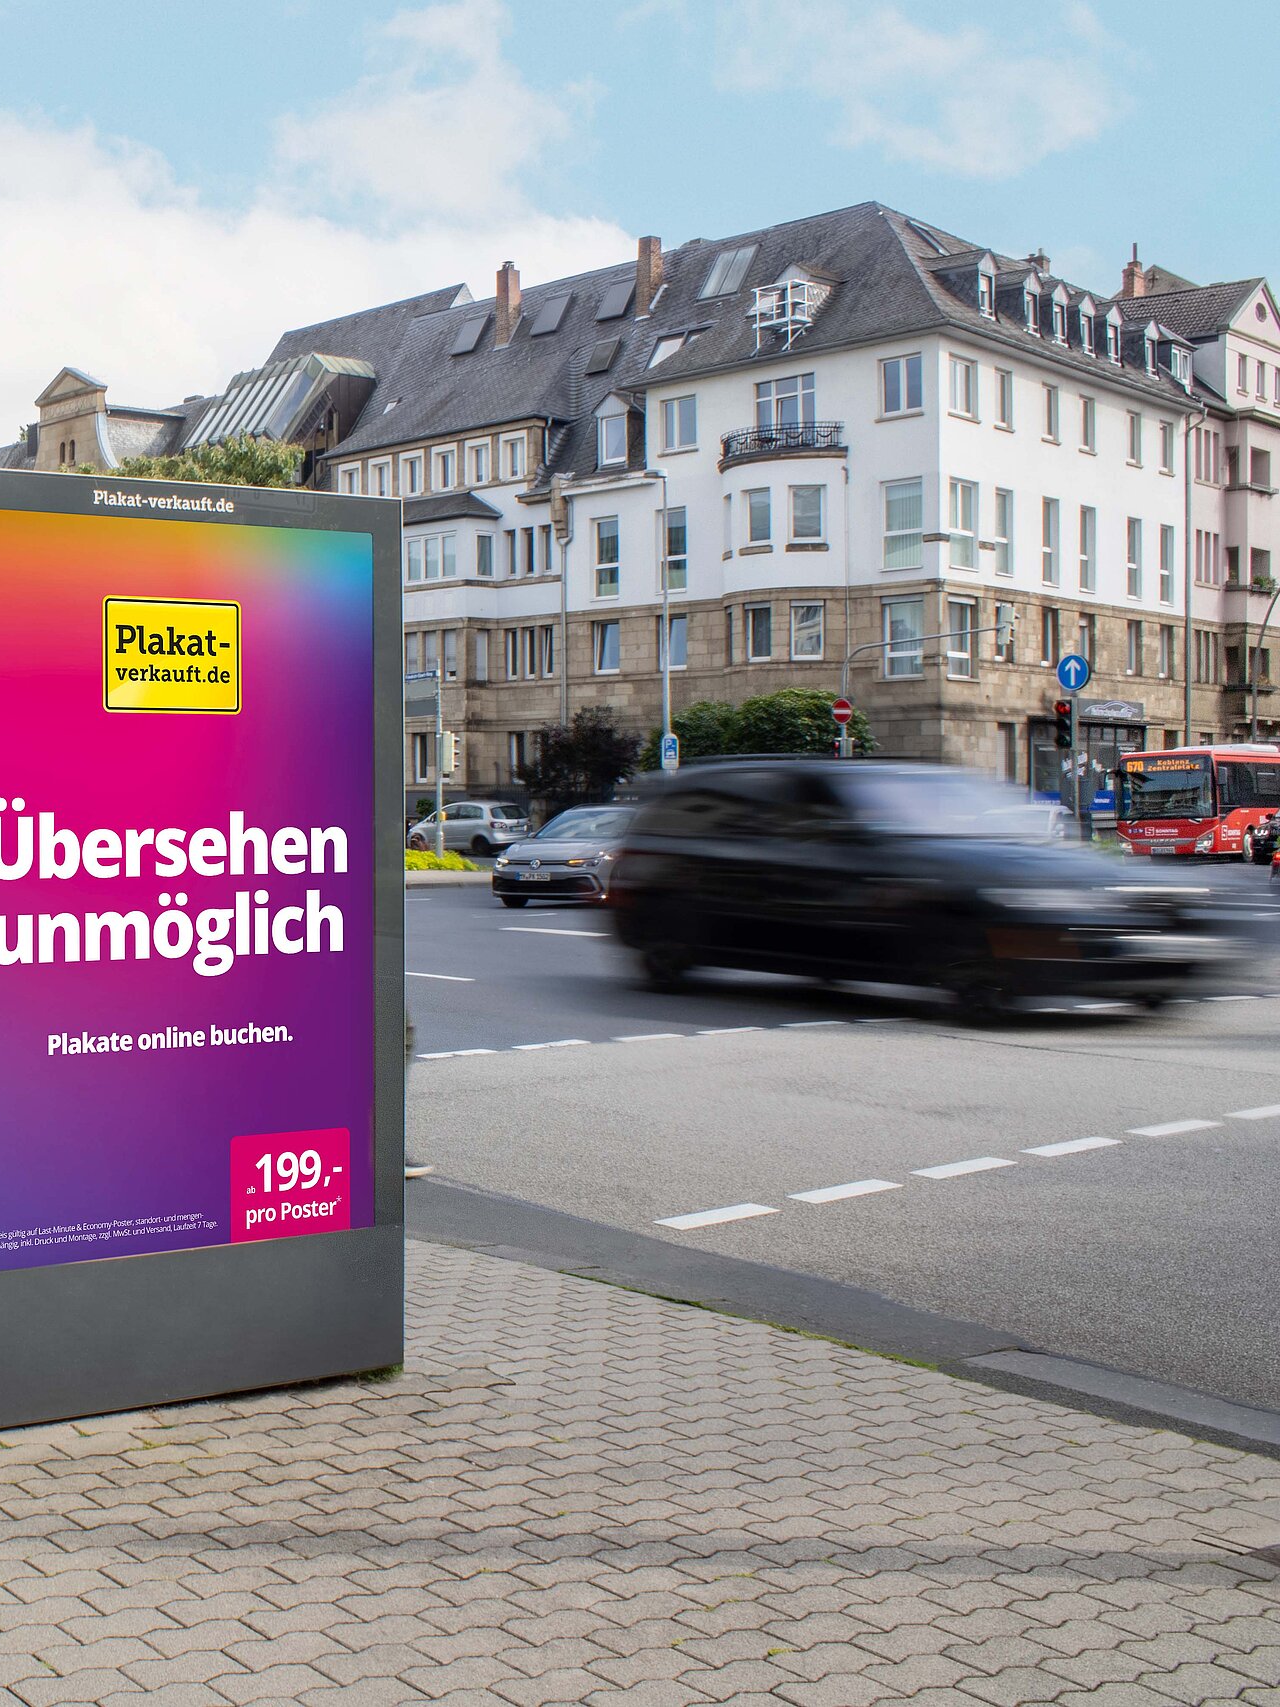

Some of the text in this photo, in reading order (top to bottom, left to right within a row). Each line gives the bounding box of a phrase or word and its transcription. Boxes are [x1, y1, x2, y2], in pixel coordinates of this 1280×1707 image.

[93, 490, 234, 513] Plakat-verkauft.de
[115, 624, 230, 657] Plakat-
[116, 664, 230, 684] verkauft.de
[1126, 761, 1144, 773] 670
[48, 1022, 294, 1056] Plakate online buchen.
[246, 1149, 343, 1195] ab 199,-
[8, 1230, 26, 1241] gültig
[26, 1227, 38, 1236] auf
[38, 1225, 76, 1235] Last-Minute
[76, 1223, 82, 1231] &
[83, 1219, 135, 1231] Economy-Poster,
[135, 1216, 163, 1226] standort-
[163, 1214, 177, 1222] und
[177, 1212, 204, 1222] mengen-
[246, 1207, 277, 1230] pro
[20, 1238, 33, 1247] inkl.
[34, 1236, 54, 1246] Druck
[54, 1235, 68, 1244] und
[68, 1232, 97, 1242] Montage,
[99, 1230, 112, 1240] zzgl.
[113, 1228, 131, 1237] MwSt.
[132, 1226, 146, 1236] und
[146, 1224, 173, 1234] Versand,
[173, 1222, 197, 1231] Laufzeit
[197, 1221, 202, 1229] 7
[202, 1220, 219, 1230] Tage.
